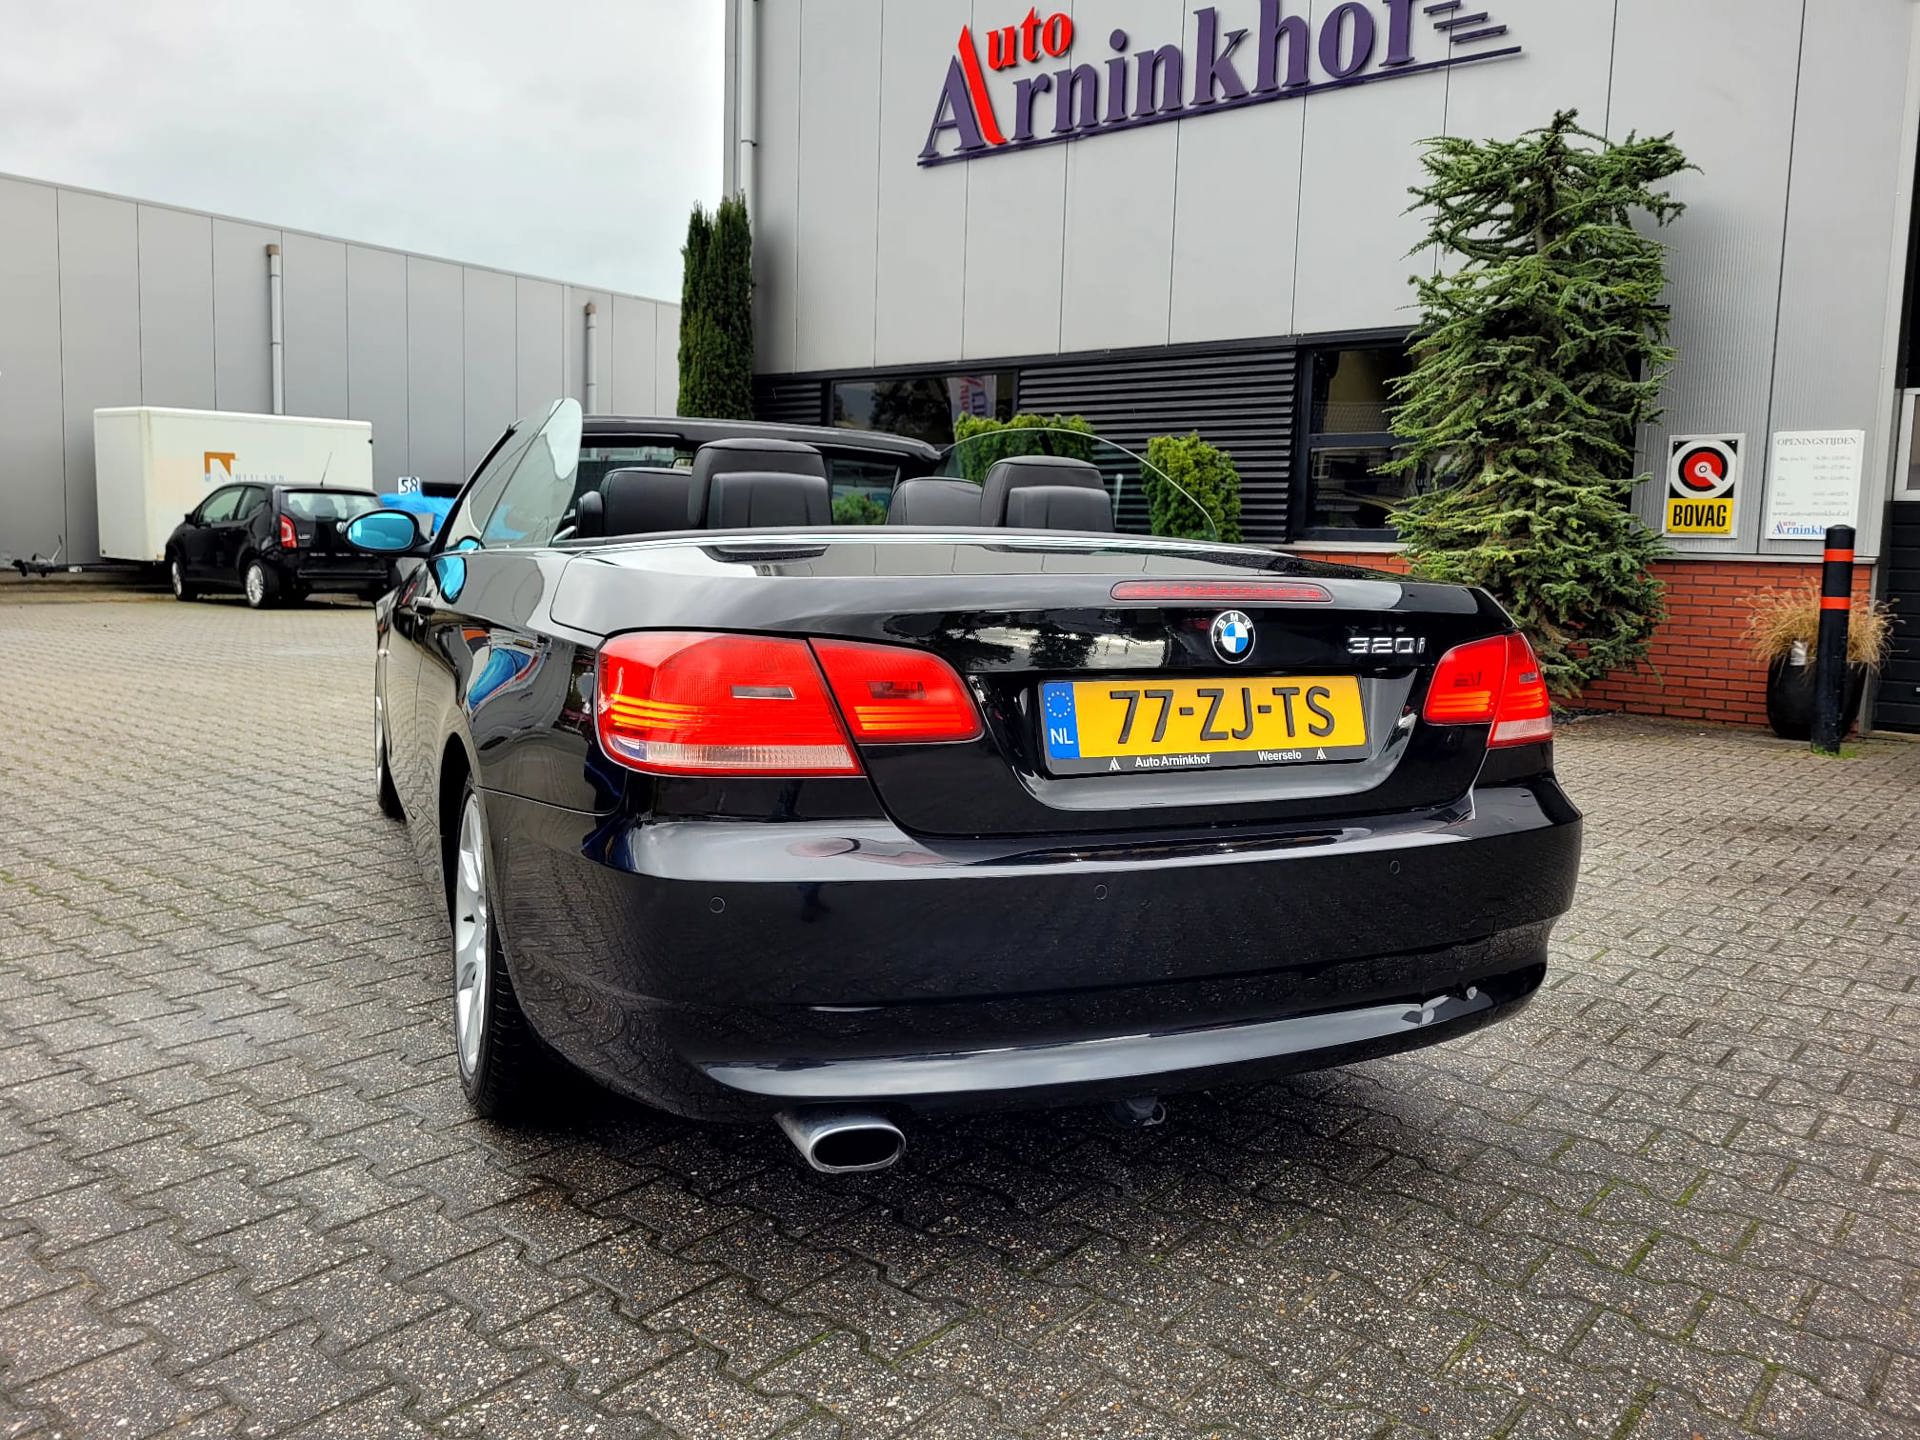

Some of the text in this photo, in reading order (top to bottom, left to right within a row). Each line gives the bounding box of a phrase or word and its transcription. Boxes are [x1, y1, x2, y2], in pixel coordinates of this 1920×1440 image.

[1672, 504, 1727, 527] BOVAG
[1771, 523, 1827, 535] Arninkh
[1216, 612, 1253, 630] BMW
[1347, 637, 1426, 654] 320i
[1109, 685, 1336, 745] 77-ZJ-TS
[1050, 727, 1074, 745] NL
[1135, 756, 1161, 768] Auto
[1161, 753, 1211, 768] Arninkhof
[1258, 750, 1302, 761] Weerselo
